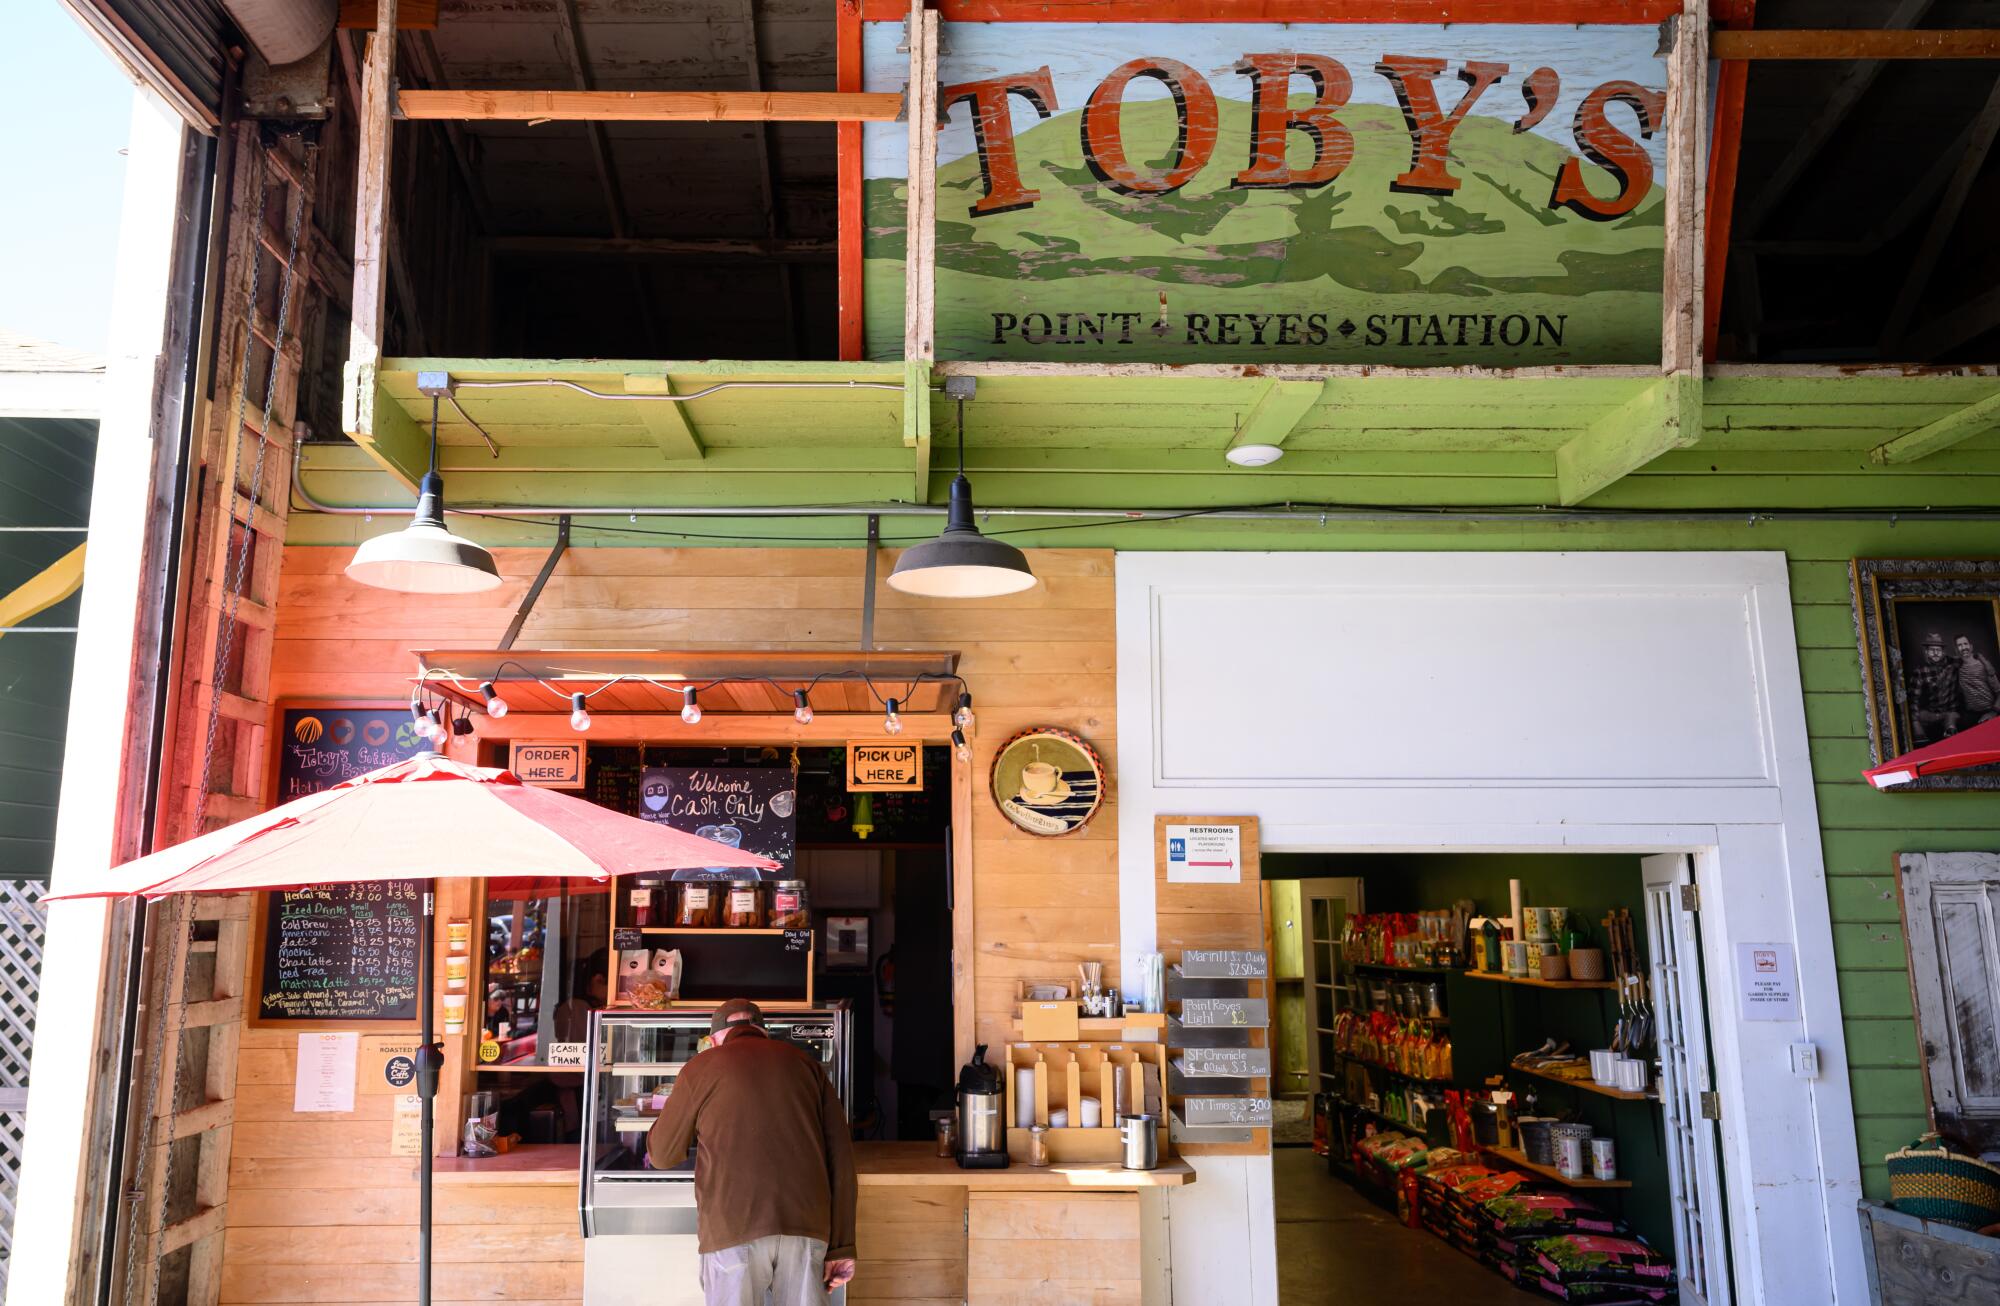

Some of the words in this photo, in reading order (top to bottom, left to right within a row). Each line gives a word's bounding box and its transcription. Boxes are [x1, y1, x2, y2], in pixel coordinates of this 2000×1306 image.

[943, 52, 1667, 222] TOBY'S
[991, 312, 1141, 345] POINT
[1184, 313, 1329, 346] REYES
[1364, 313, 1568, 347] STATION
[524, 750, 570, 761] ORDER
[858, 751, 890, 762] PICK
[894, 751, 913, 762] UP
[528, 767, 565, 778] HERE
[867, 769, 905, 781] HERE
[689, 770, 754, 794] Welcome
[671, 794, 719, 816] Cash
[725, 794, 765, 820] Only
[315, 891, 332, 901] Tea
[281, 903, 312, 916] Iced
[314, 902, 347, 915] Drinks
[281, 919, 301, 930] Cold
[301, 919, 329, 929] Brew
[281, 929, 331, 938] Americano
[279, 948, 315, 958] Mocha
[1187, 950, 1217, 962] Marin
[279, 967, 300, 980] Iced
[303, 967, 328, 976] Tea
[1253, 967, 1265, 975] Sun
[1186, 1000, 1211, 1011] Point
[1213, 999, 1241, 1015] Reyes
[1187, 1011, 1214, 1026] Light
[1231, 1010, 1248, 1025] $2
[481, 1048, 499, 1058] FEED
[556, 1045, 578, 1054] CASH
[1204, 1048, 1247, 1060] Chronicle
[551, 1056, 581, 1065] THANK
